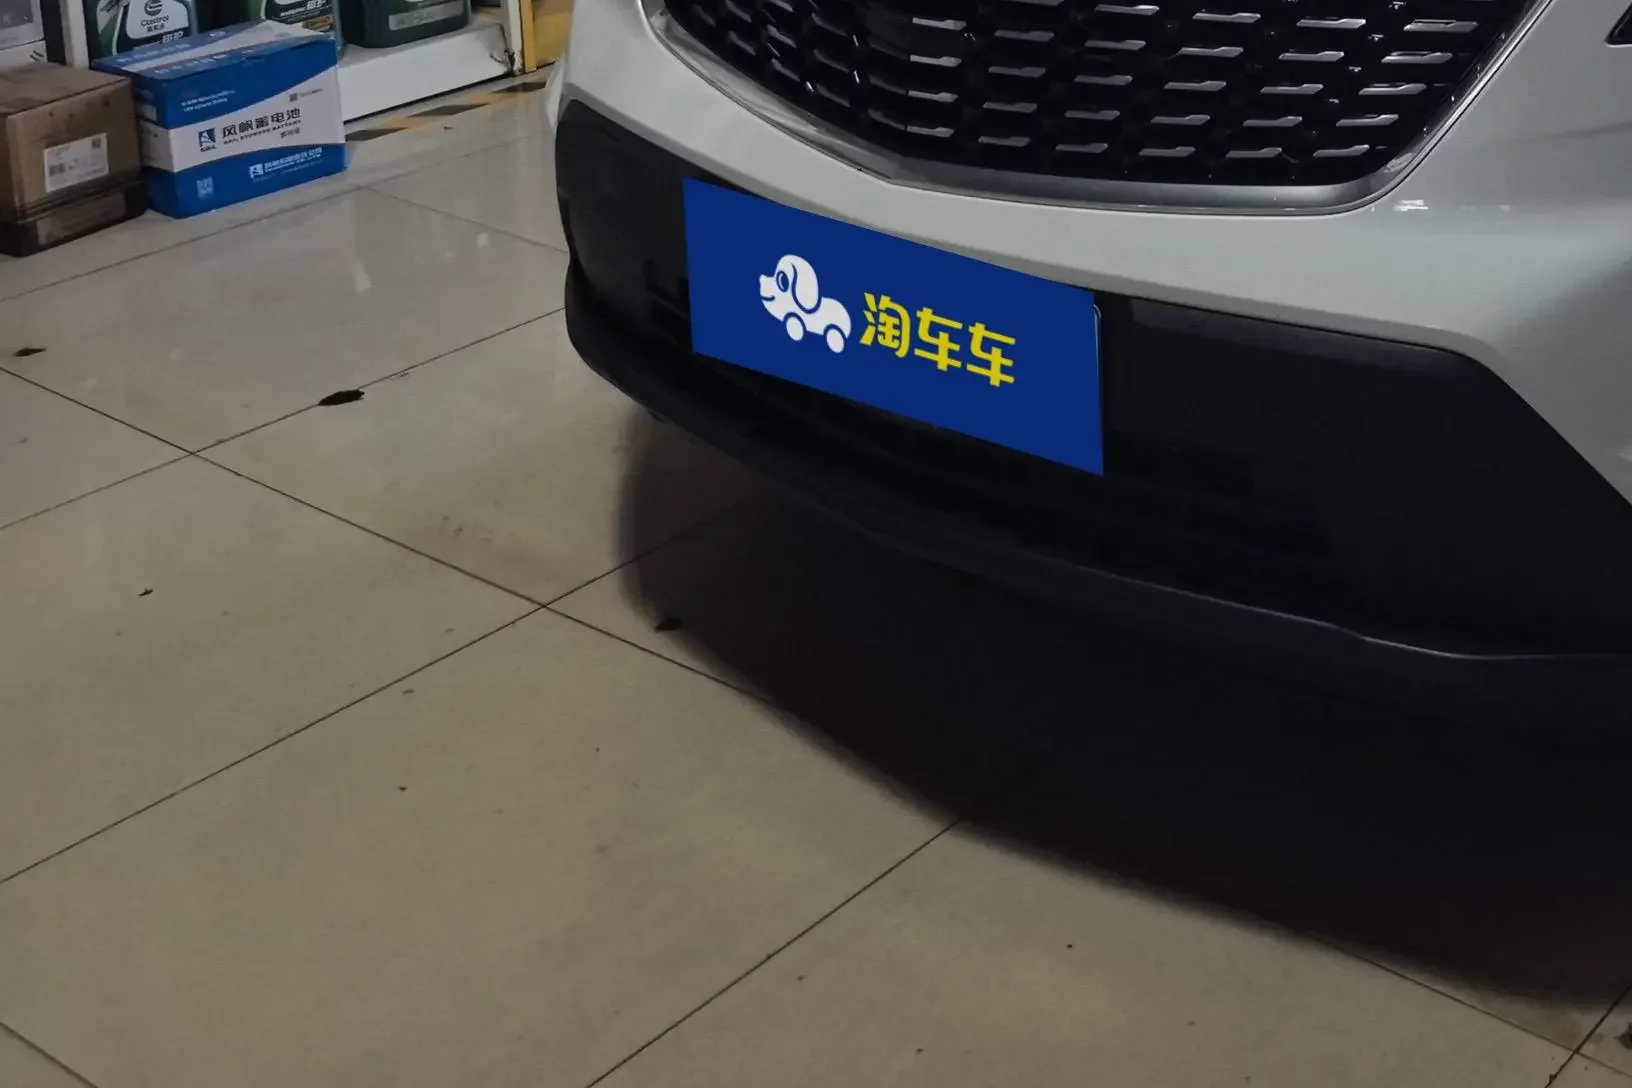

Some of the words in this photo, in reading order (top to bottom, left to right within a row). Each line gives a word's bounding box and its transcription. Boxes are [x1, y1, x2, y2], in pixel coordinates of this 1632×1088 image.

[141, 15, 170, 27] Castrol
[222, 107, 302, 139] 风帆蓄电池
